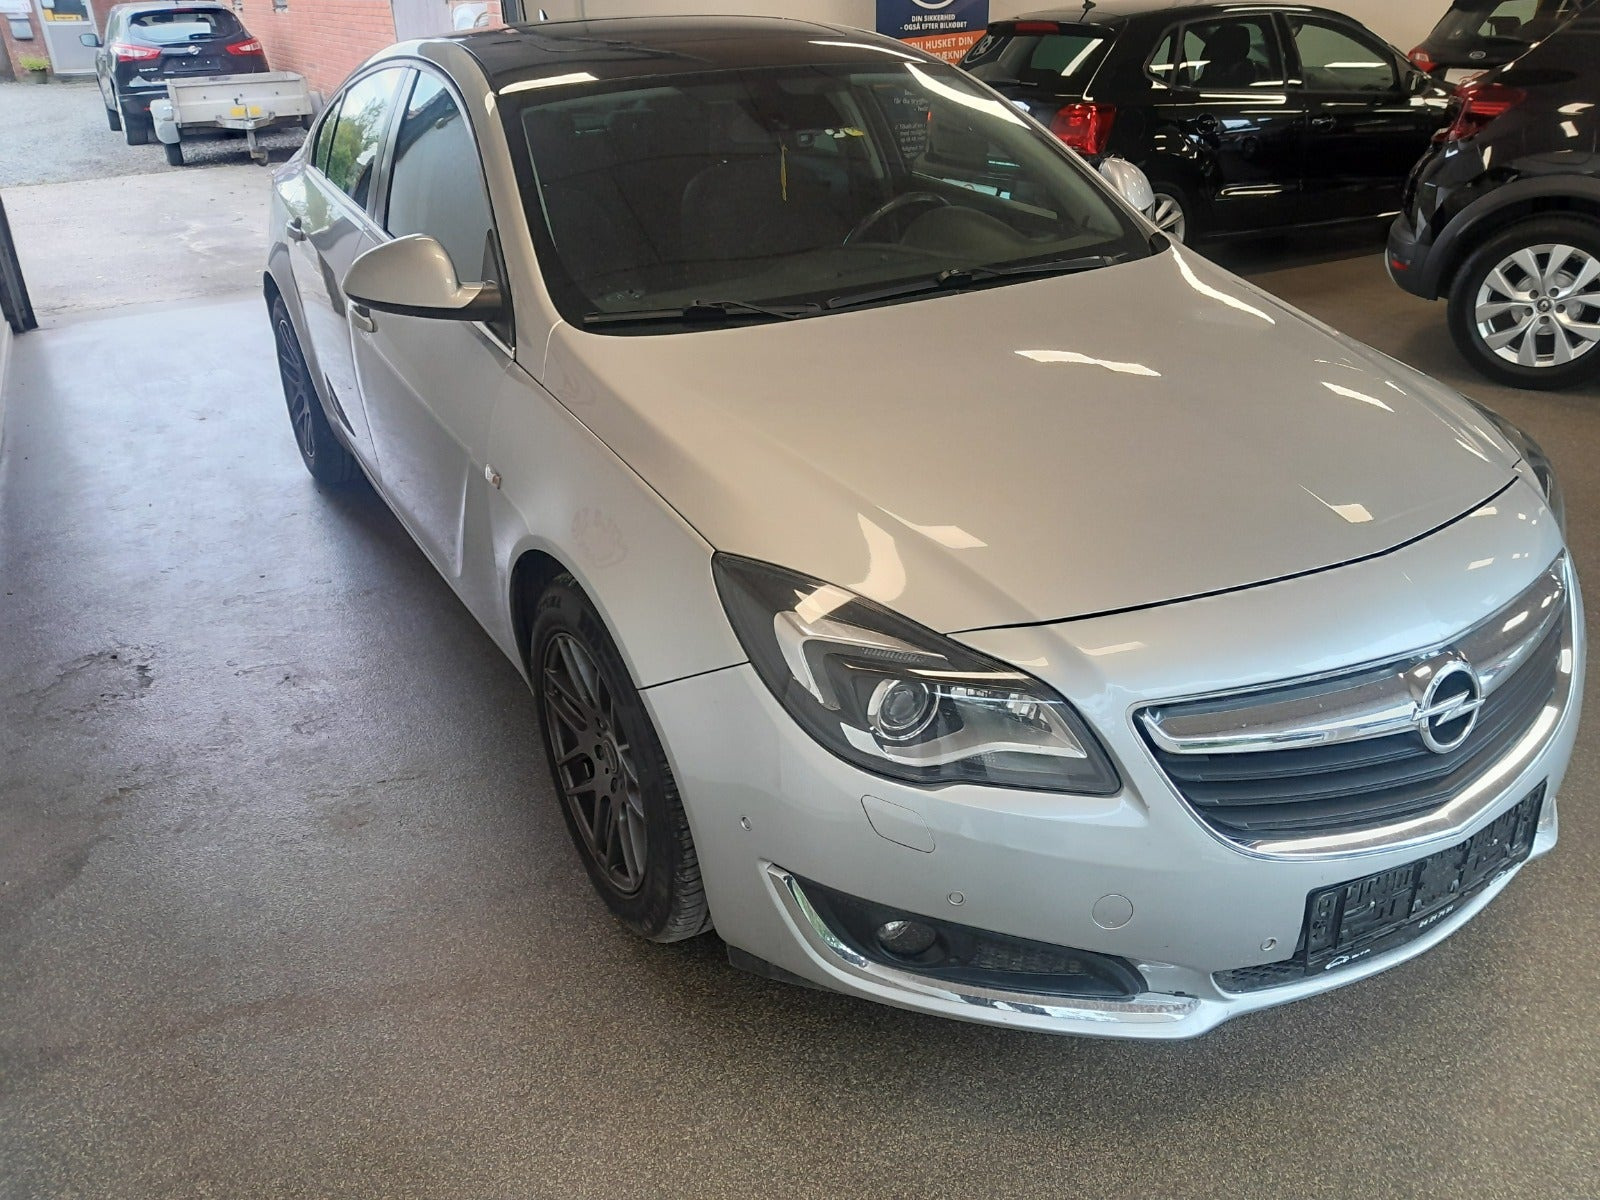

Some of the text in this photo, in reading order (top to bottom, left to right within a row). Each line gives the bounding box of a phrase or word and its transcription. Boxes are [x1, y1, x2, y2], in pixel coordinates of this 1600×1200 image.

[904, 22, 921, 30] OGSÅ
[925, 38, 956, 49] HUSKET
[959, 37, 973, 45] DIN
